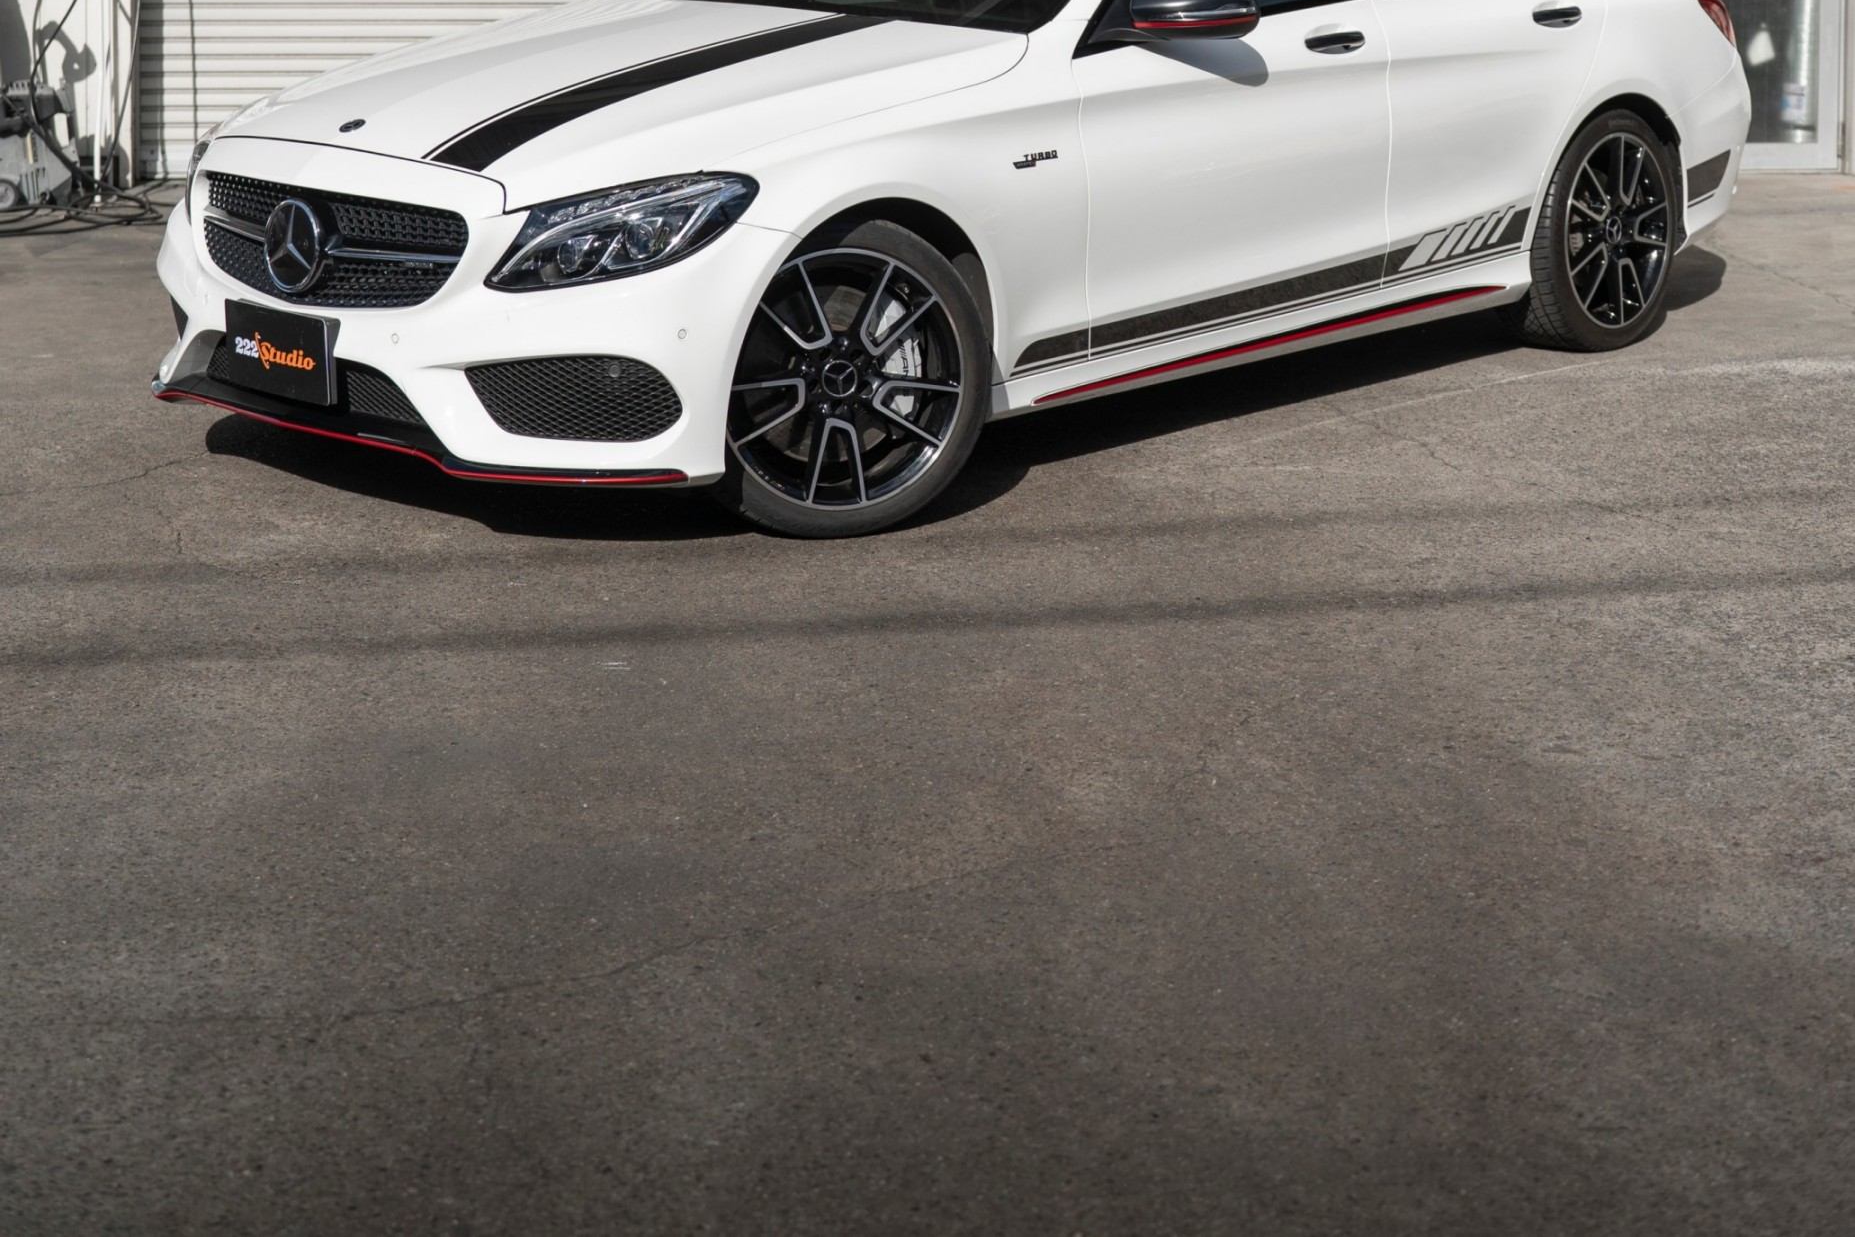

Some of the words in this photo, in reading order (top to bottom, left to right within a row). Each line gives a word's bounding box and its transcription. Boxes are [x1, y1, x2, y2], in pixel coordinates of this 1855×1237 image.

[1023, 149, 1059, 162] TURBO
[235, 336, 259, 358] 222
[258, 336, 317, 370] Studio
